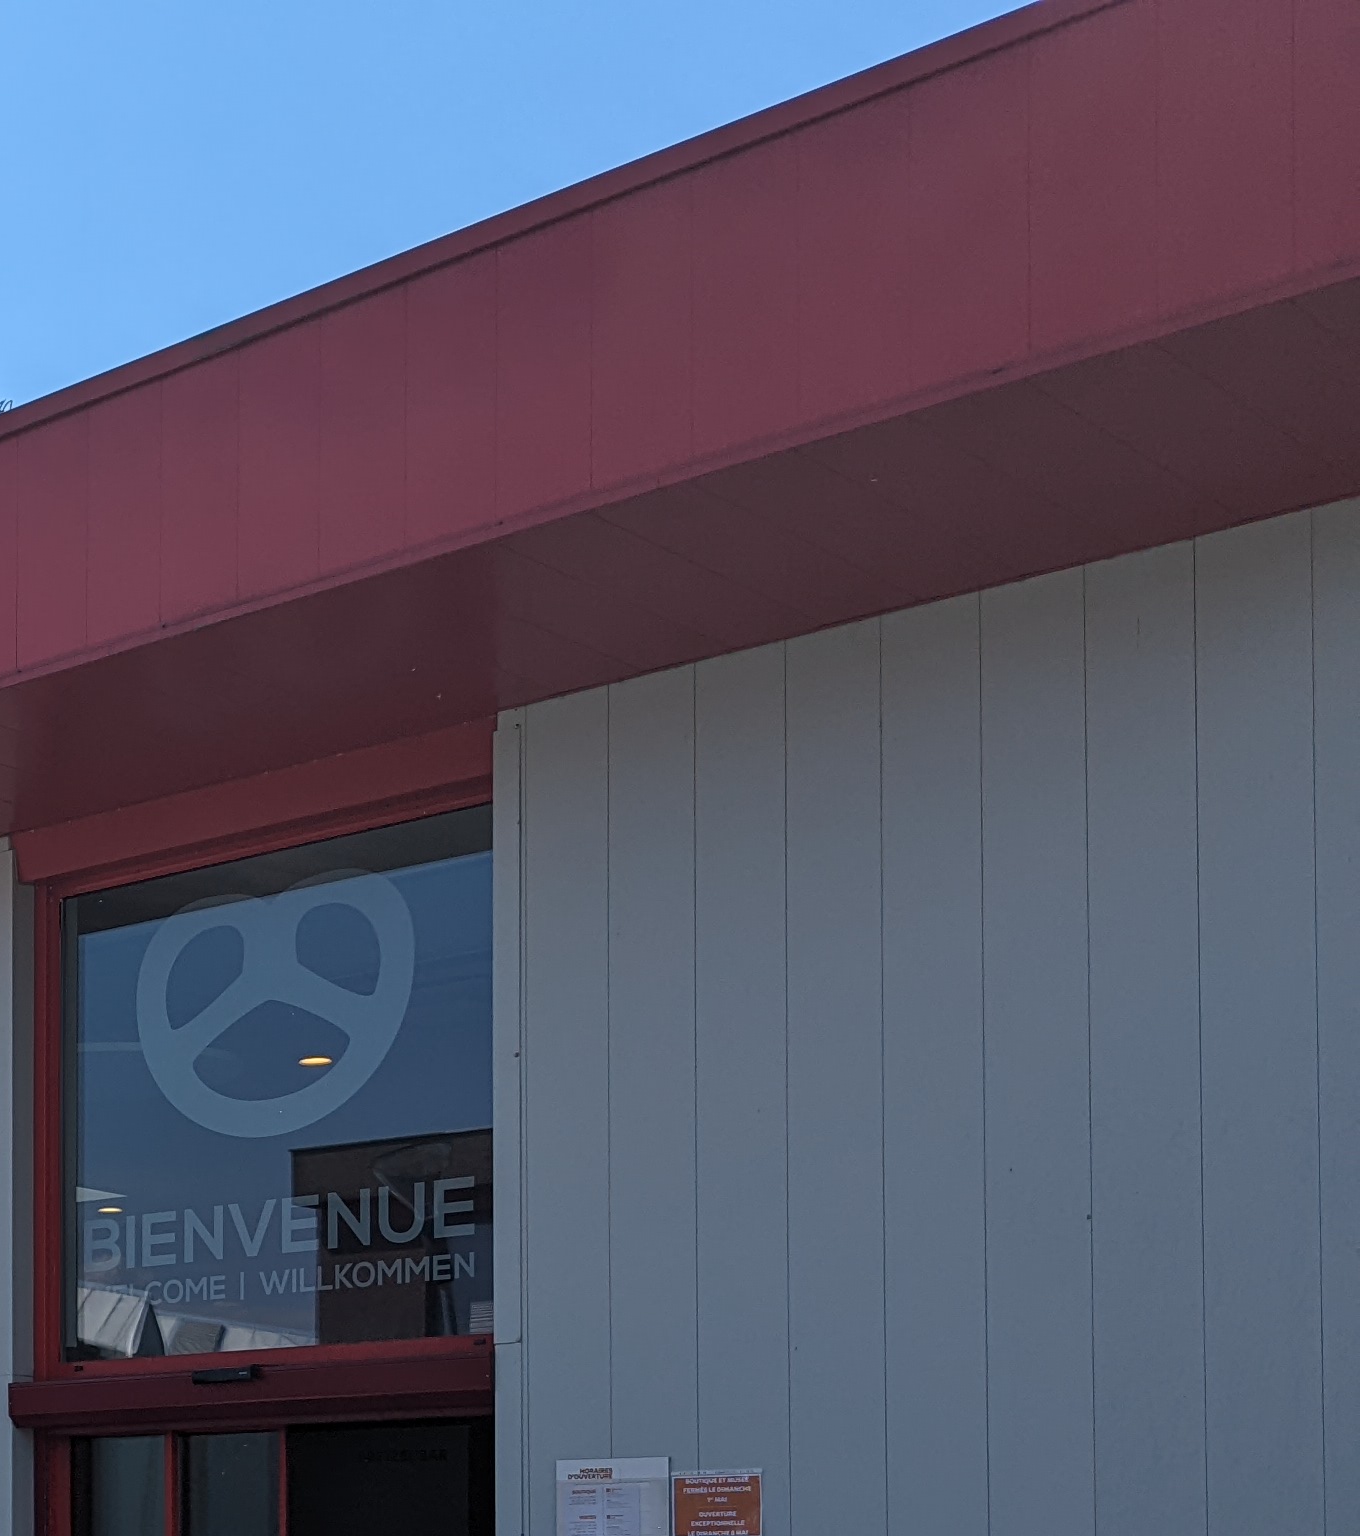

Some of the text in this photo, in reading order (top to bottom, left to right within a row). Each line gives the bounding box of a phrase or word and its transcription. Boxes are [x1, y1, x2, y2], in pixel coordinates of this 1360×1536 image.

[84, 1175, 476, 1273] BIENVENUE
[94, 1273, 227, 1306] COME
[261, 1251, 476, 1296] WILLKOMMEN
